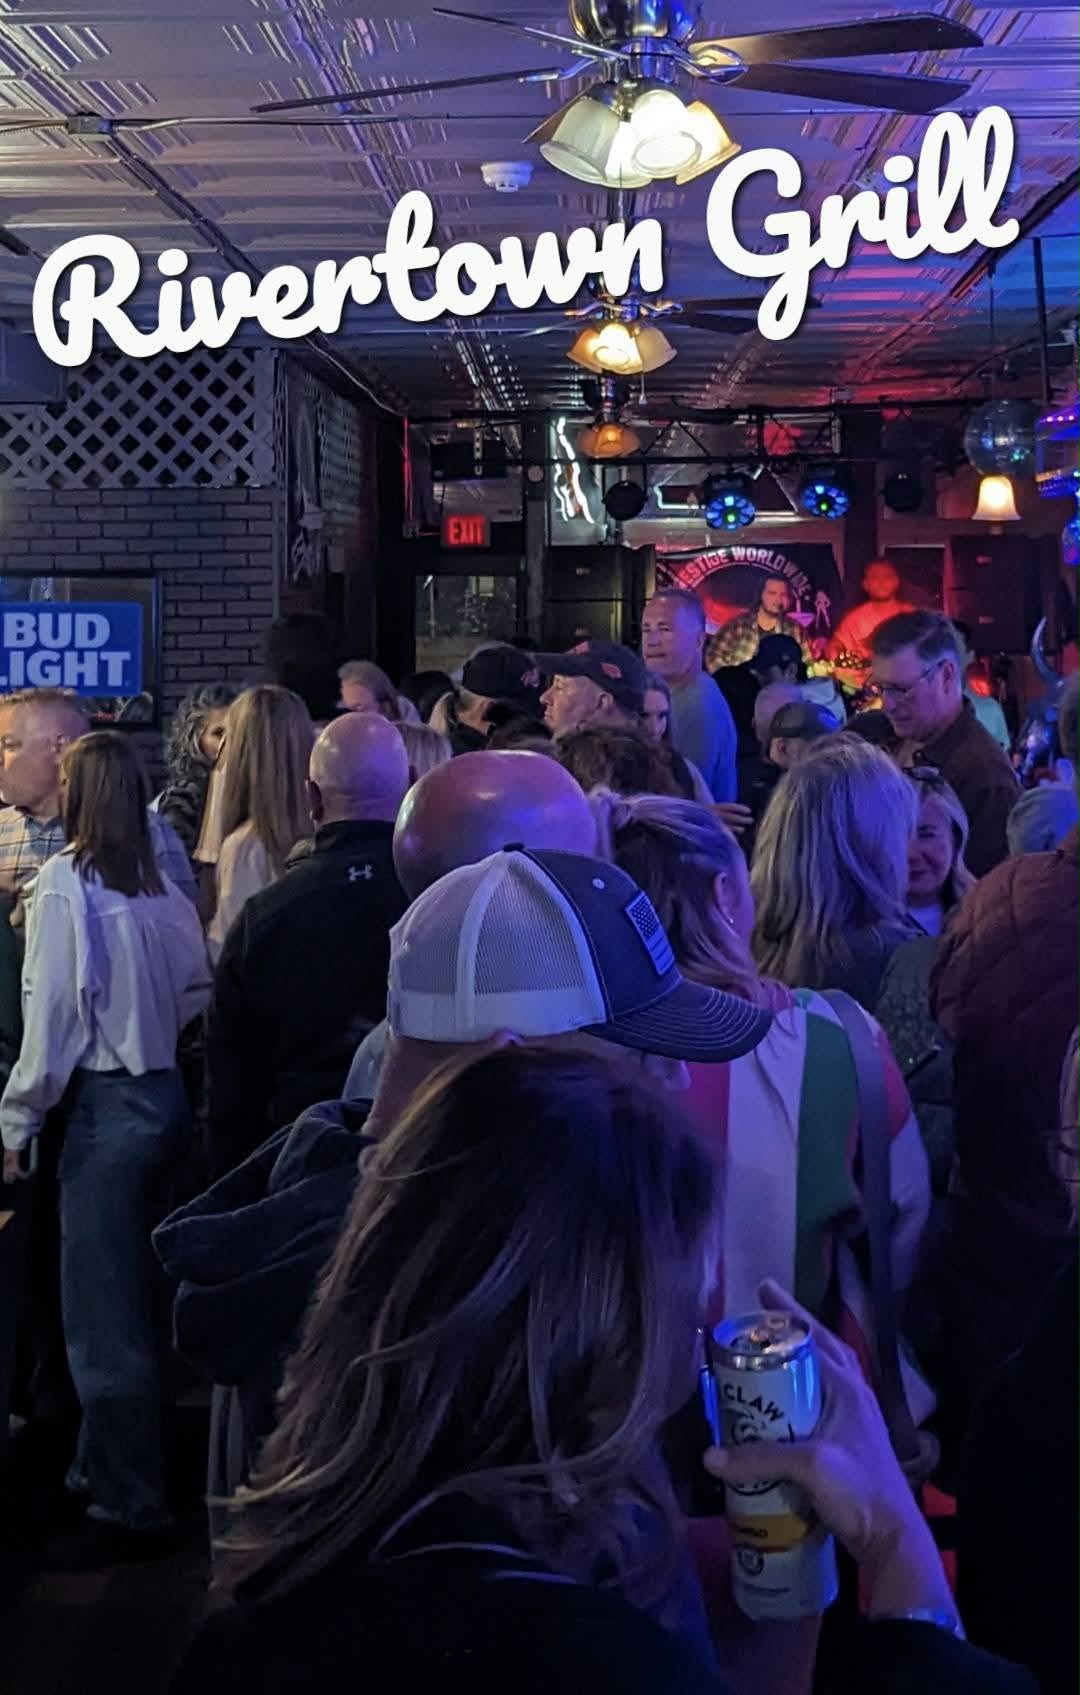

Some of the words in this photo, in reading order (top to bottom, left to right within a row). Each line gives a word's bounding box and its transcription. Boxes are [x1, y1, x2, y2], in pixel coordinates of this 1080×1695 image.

[449, 516, 485, 545] EXIT
[676, 548, 729, 586] ESTIGE
[3, 612, 110, 649] BUD
[0, 650, 131, 687] IGHT
[723, 1383, 784, 1421] CLAW
